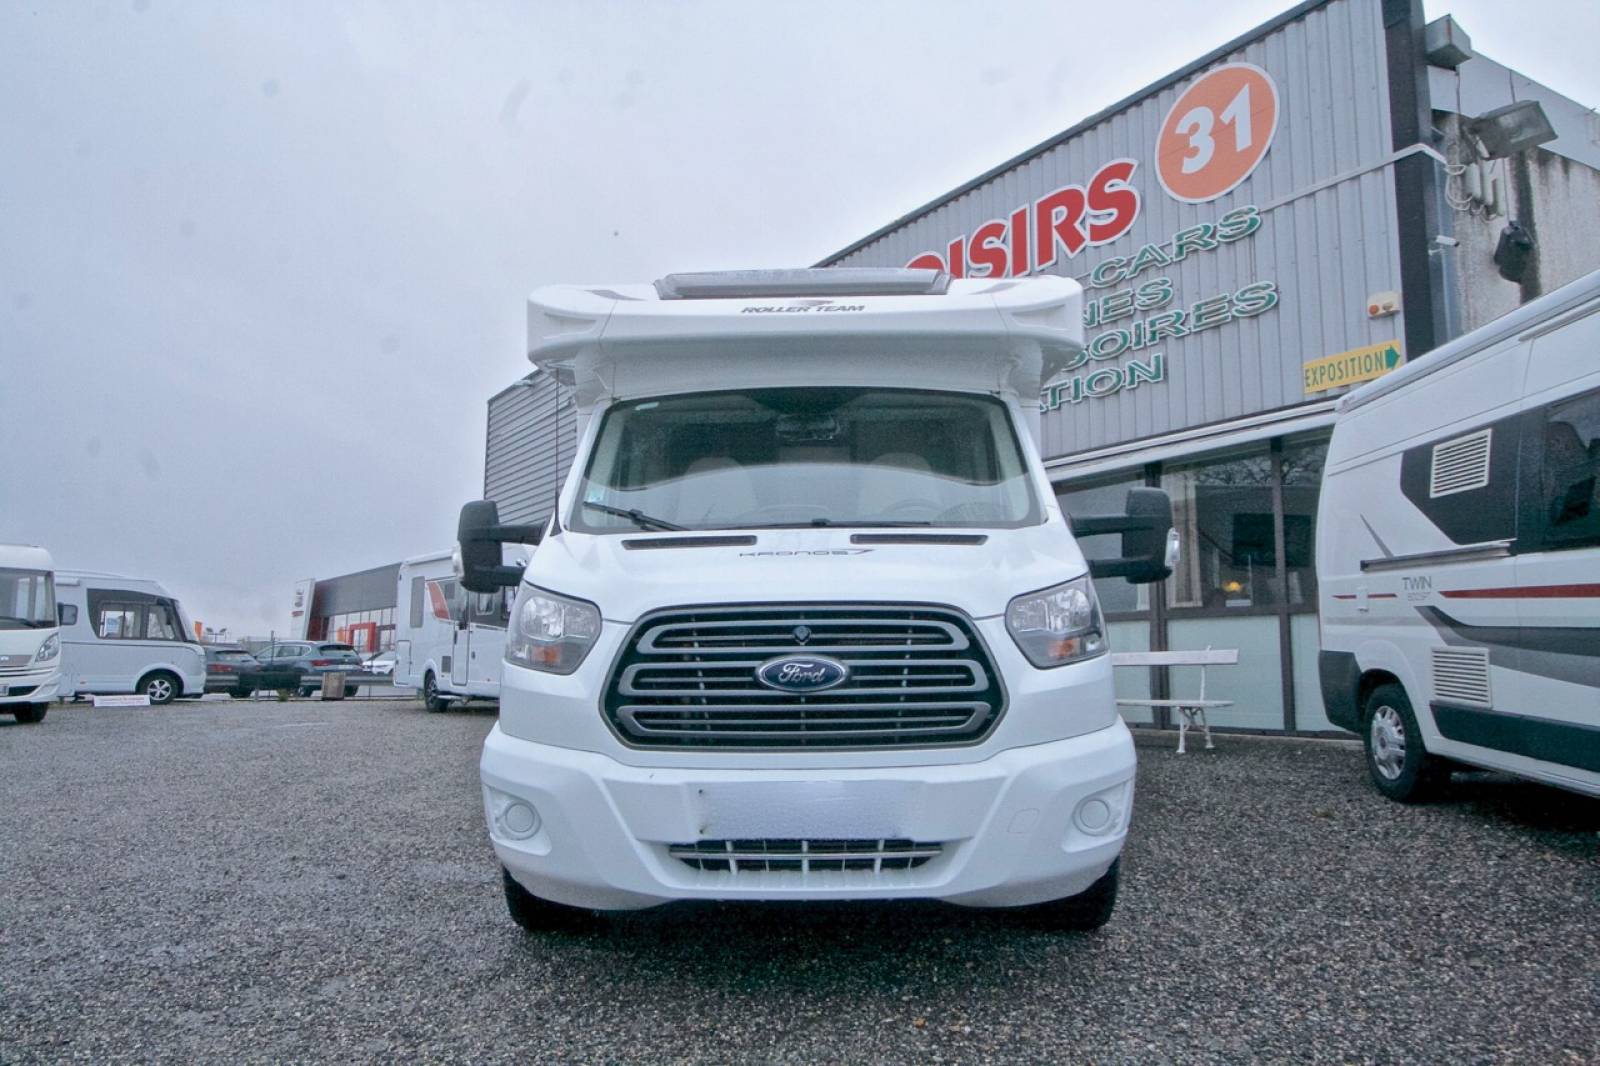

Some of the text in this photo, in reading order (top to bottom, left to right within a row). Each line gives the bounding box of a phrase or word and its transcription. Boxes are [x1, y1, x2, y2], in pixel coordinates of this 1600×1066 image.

[1175, 82, 1253, 174] 31
[1091, 205, 1261, 288] CARS
[1304, 350, 1385, 388] EXPOSITION
[1401, 576, 1432, 590] TWIN
[778, 663, 826, 682] Ford
